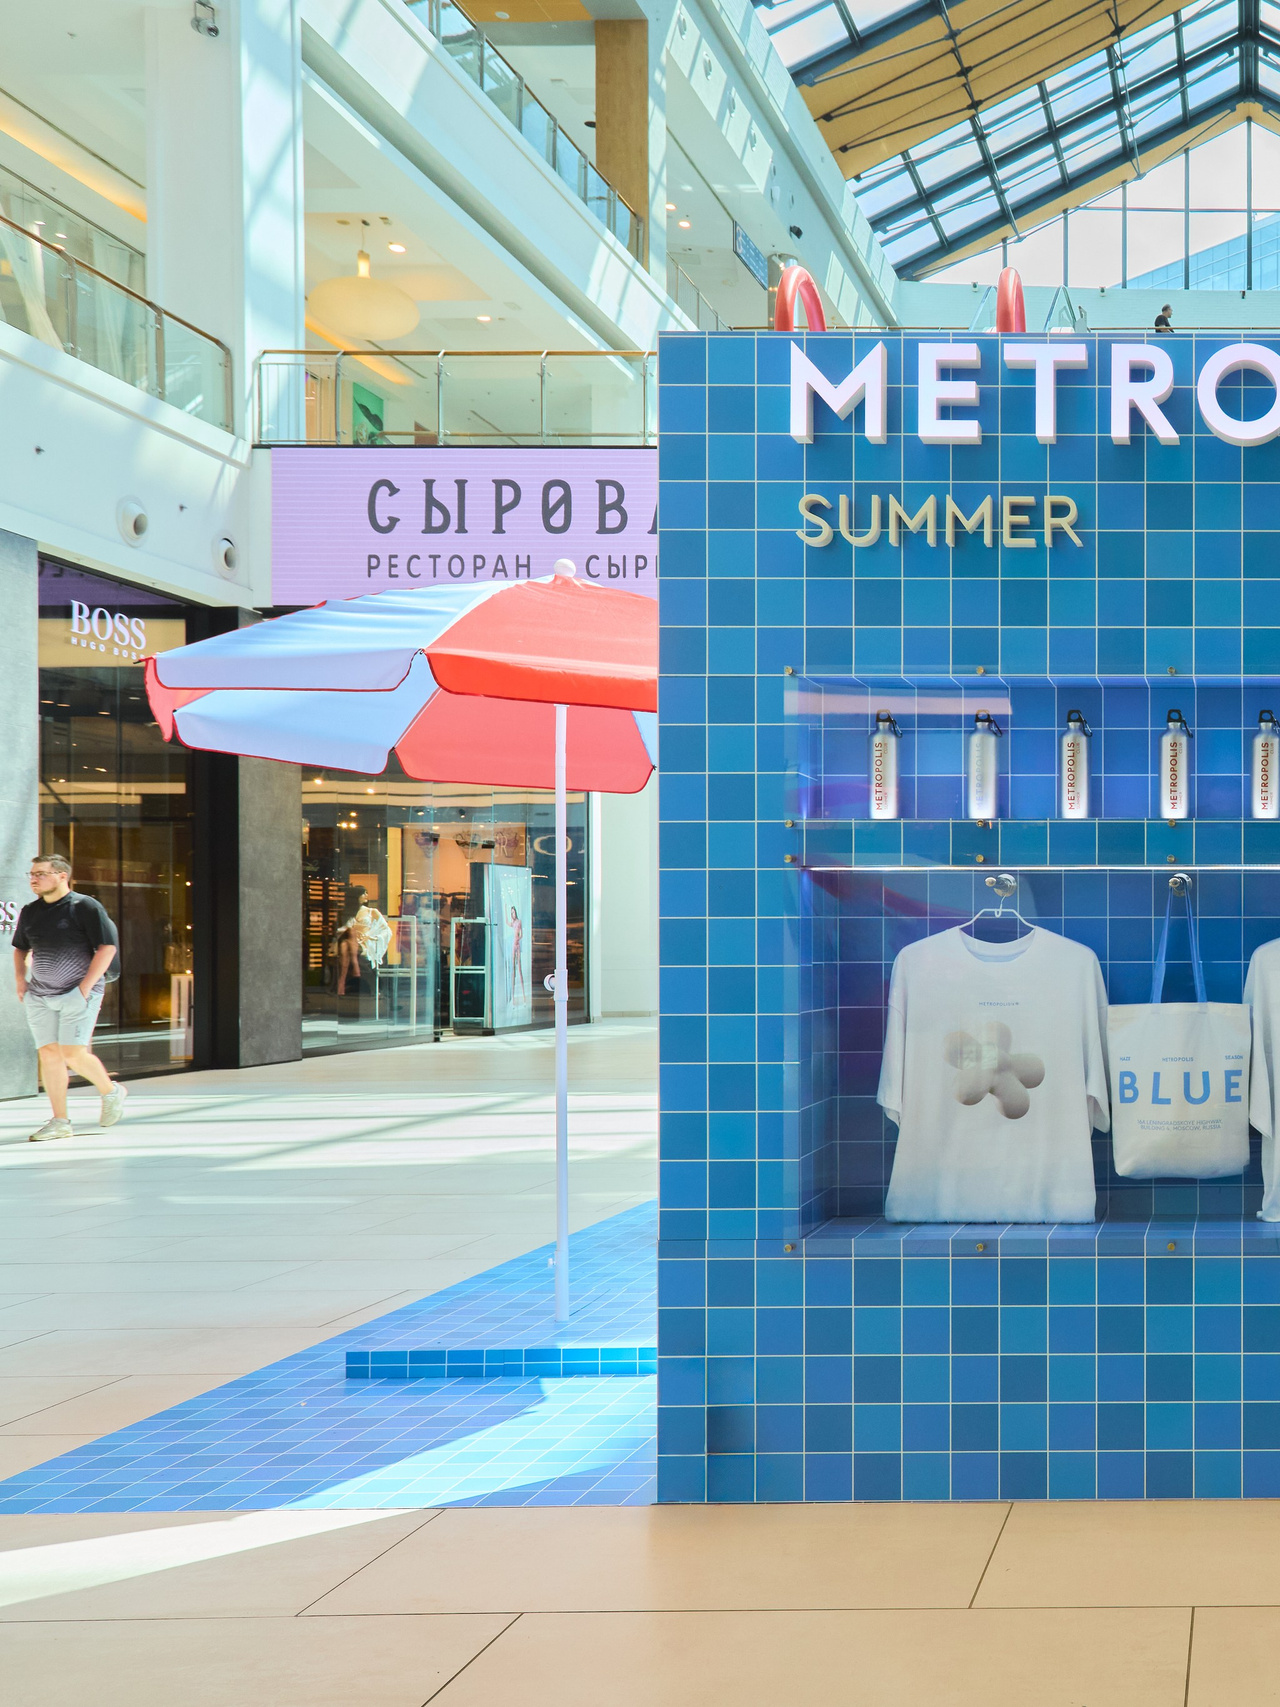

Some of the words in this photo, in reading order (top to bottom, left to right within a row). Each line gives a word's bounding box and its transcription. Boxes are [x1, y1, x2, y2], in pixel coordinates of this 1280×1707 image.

[367, 479, 657, 534] СЫРОВ
[795, 493, 1084, 548] SUMMER
[367, 555, 531, 578] РЕСТОРАН
[585, 555, 657, 578] СЫР
[71, 600, 147, 650] BOSS
[71, 637, 106, 652] HUGO
[875, 742, 883, 810] METROPOLIS
[1067, 742, 1075, 810] METROPOLIS
[1169, 741, 1178, 810] METROPOLIS
[1261, 742, 1269, 810] METROPOLIS
[1119, 1069, 1243, 1105] BLUE
